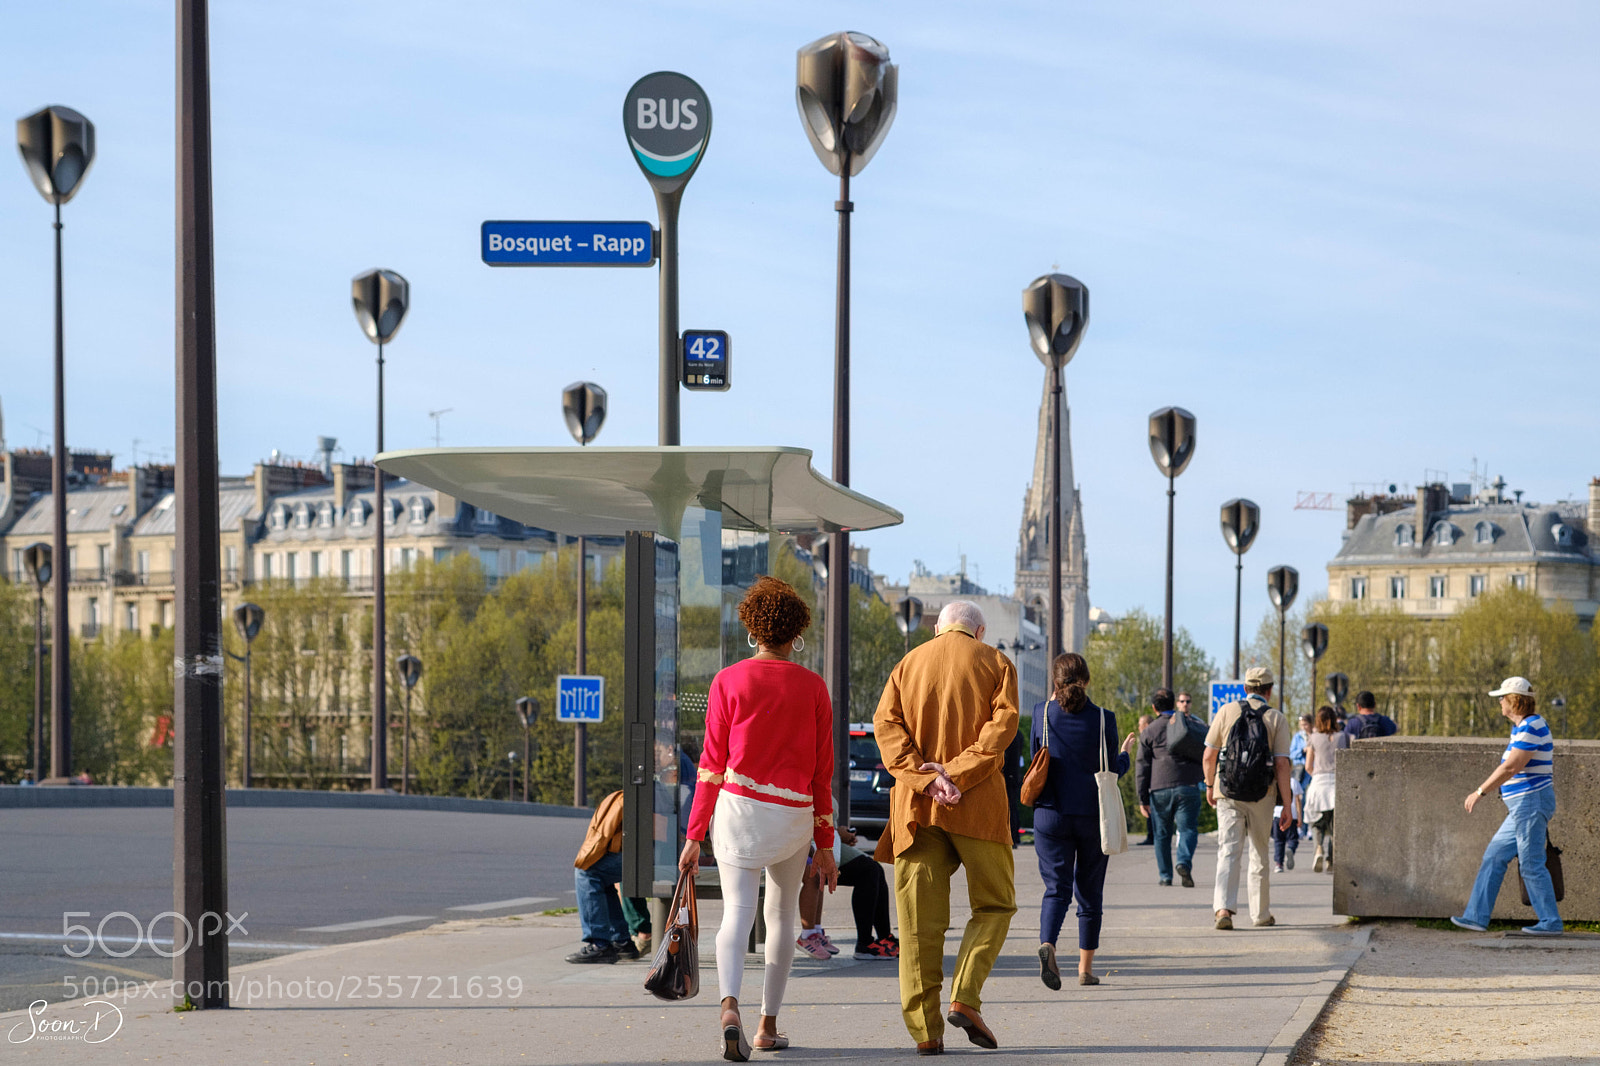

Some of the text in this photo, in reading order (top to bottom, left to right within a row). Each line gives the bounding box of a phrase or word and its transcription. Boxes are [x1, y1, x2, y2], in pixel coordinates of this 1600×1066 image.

[637, 97, 698, 130] BUS
[488, 233, 572, 256] Bosquet
[593, 234, 645, 256] Rapp
[689, 337, 720, 359] 42
[703, 374, 710, 384] 6
